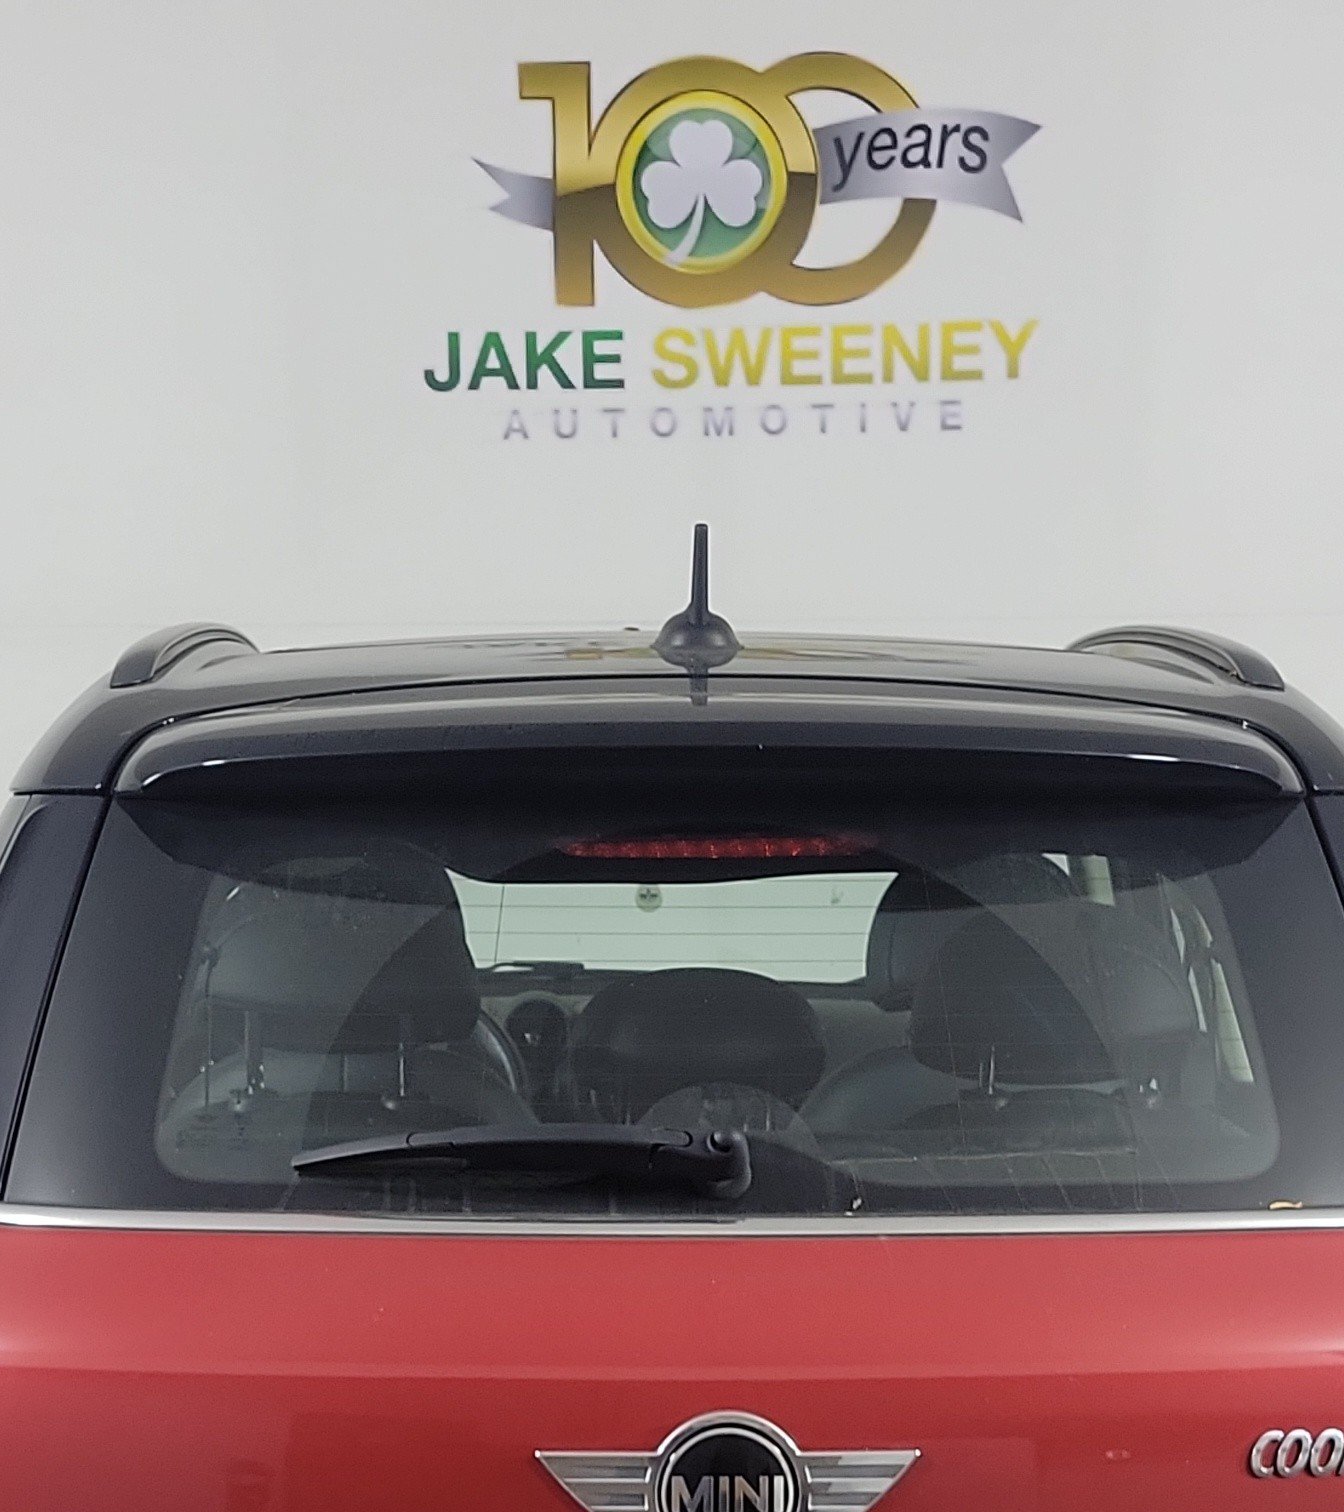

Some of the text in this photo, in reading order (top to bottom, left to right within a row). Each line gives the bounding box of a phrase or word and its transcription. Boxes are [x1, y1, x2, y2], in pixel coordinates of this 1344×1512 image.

[517, 51, 937, 308] 100
[831, 121, 991, 193] years
[423, 319, 1040, 393] JAKE SWEENEY
[501, 400, 965, 441] AUTOMOTIVE
